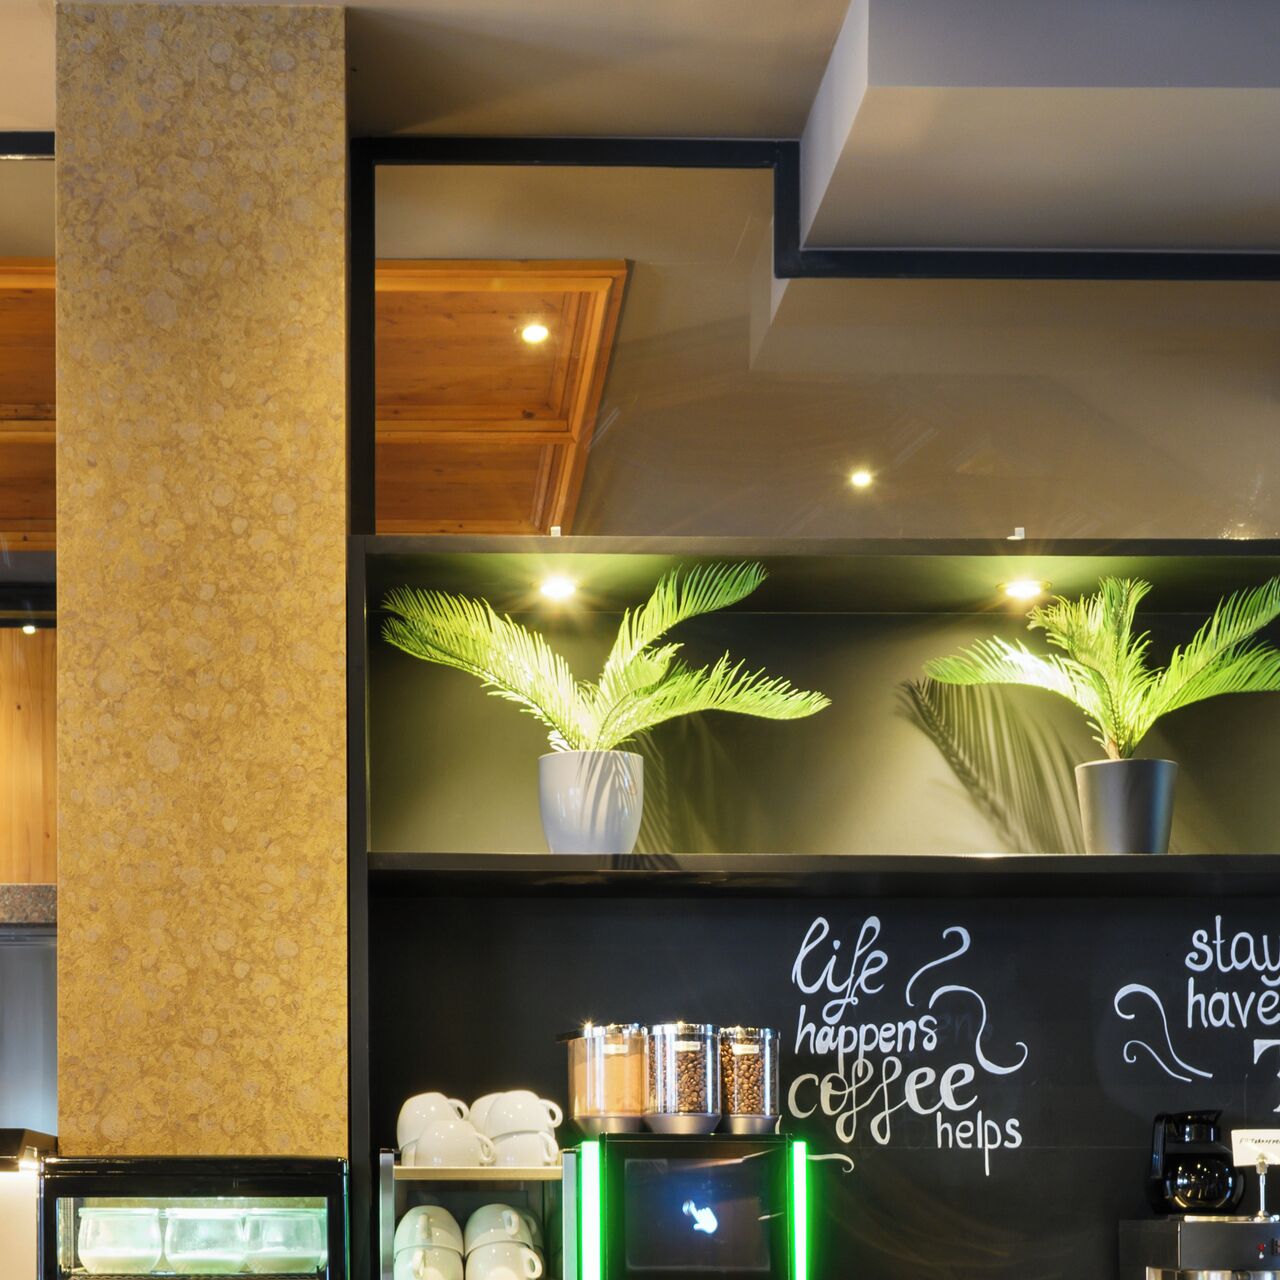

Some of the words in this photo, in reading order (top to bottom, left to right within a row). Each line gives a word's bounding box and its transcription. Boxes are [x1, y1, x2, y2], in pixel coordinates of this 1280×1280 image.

[792, 916, 888, 1025] life
[795, 1004, 938, 1078] happens
[788, 1056, 978, 1145] coffee
[936, 1110, 1022, 1177] helps
